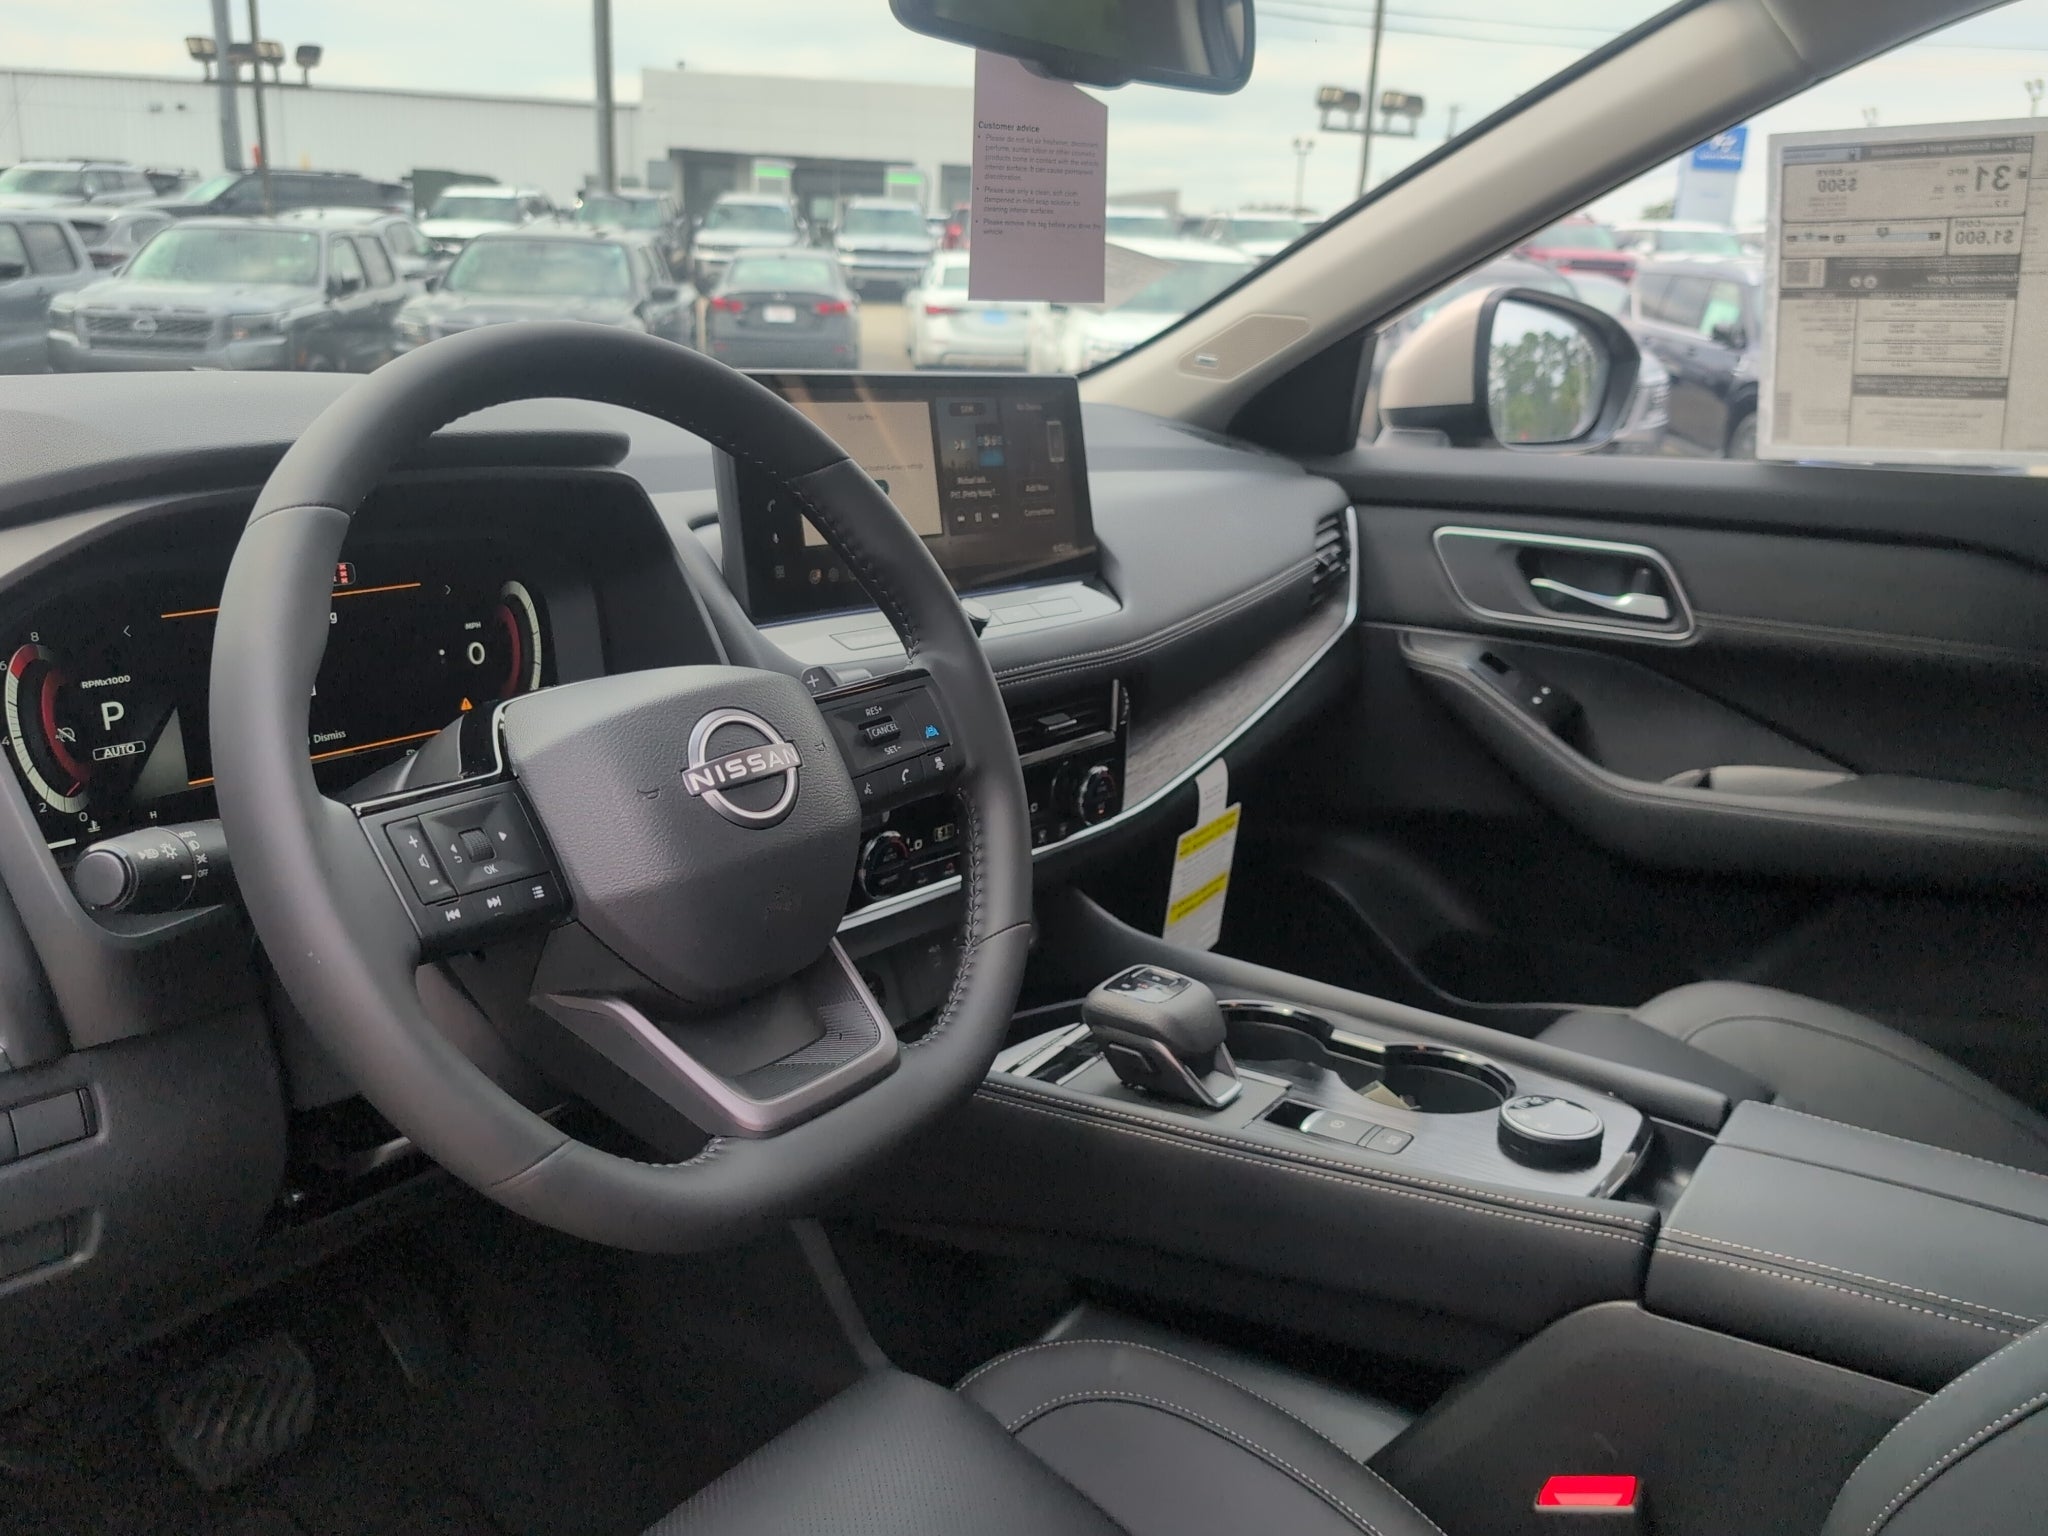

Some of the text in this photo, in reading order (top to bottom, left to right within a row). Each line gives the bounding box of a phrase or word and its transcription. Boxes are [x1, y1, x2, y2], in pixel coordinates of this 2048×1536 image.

[978, 121, 1040, 133] Customer advice
[465, 621, 481, 630] MPH
[30, 631, 40, 642] 8
[467, 641, 486, 665] 0
[0, 661, 8, 671] 6
[81, 675, 131, 689] RPMx1000
[100, 701, 125, 731] P
[313, 729, 347, 744] Dismiss
[871, 723, 899, 738] CANCEL
[1, 736, 10, 746] 4
[103, 745, 136, 758] AUTO
[687, 745, 798, 792] NISSAN
[38, 803, 48, 813] 2
[78, 812, 89, 822] 0
[149, 811, 158, 819] H
[483, 863, 499, 875] OK
